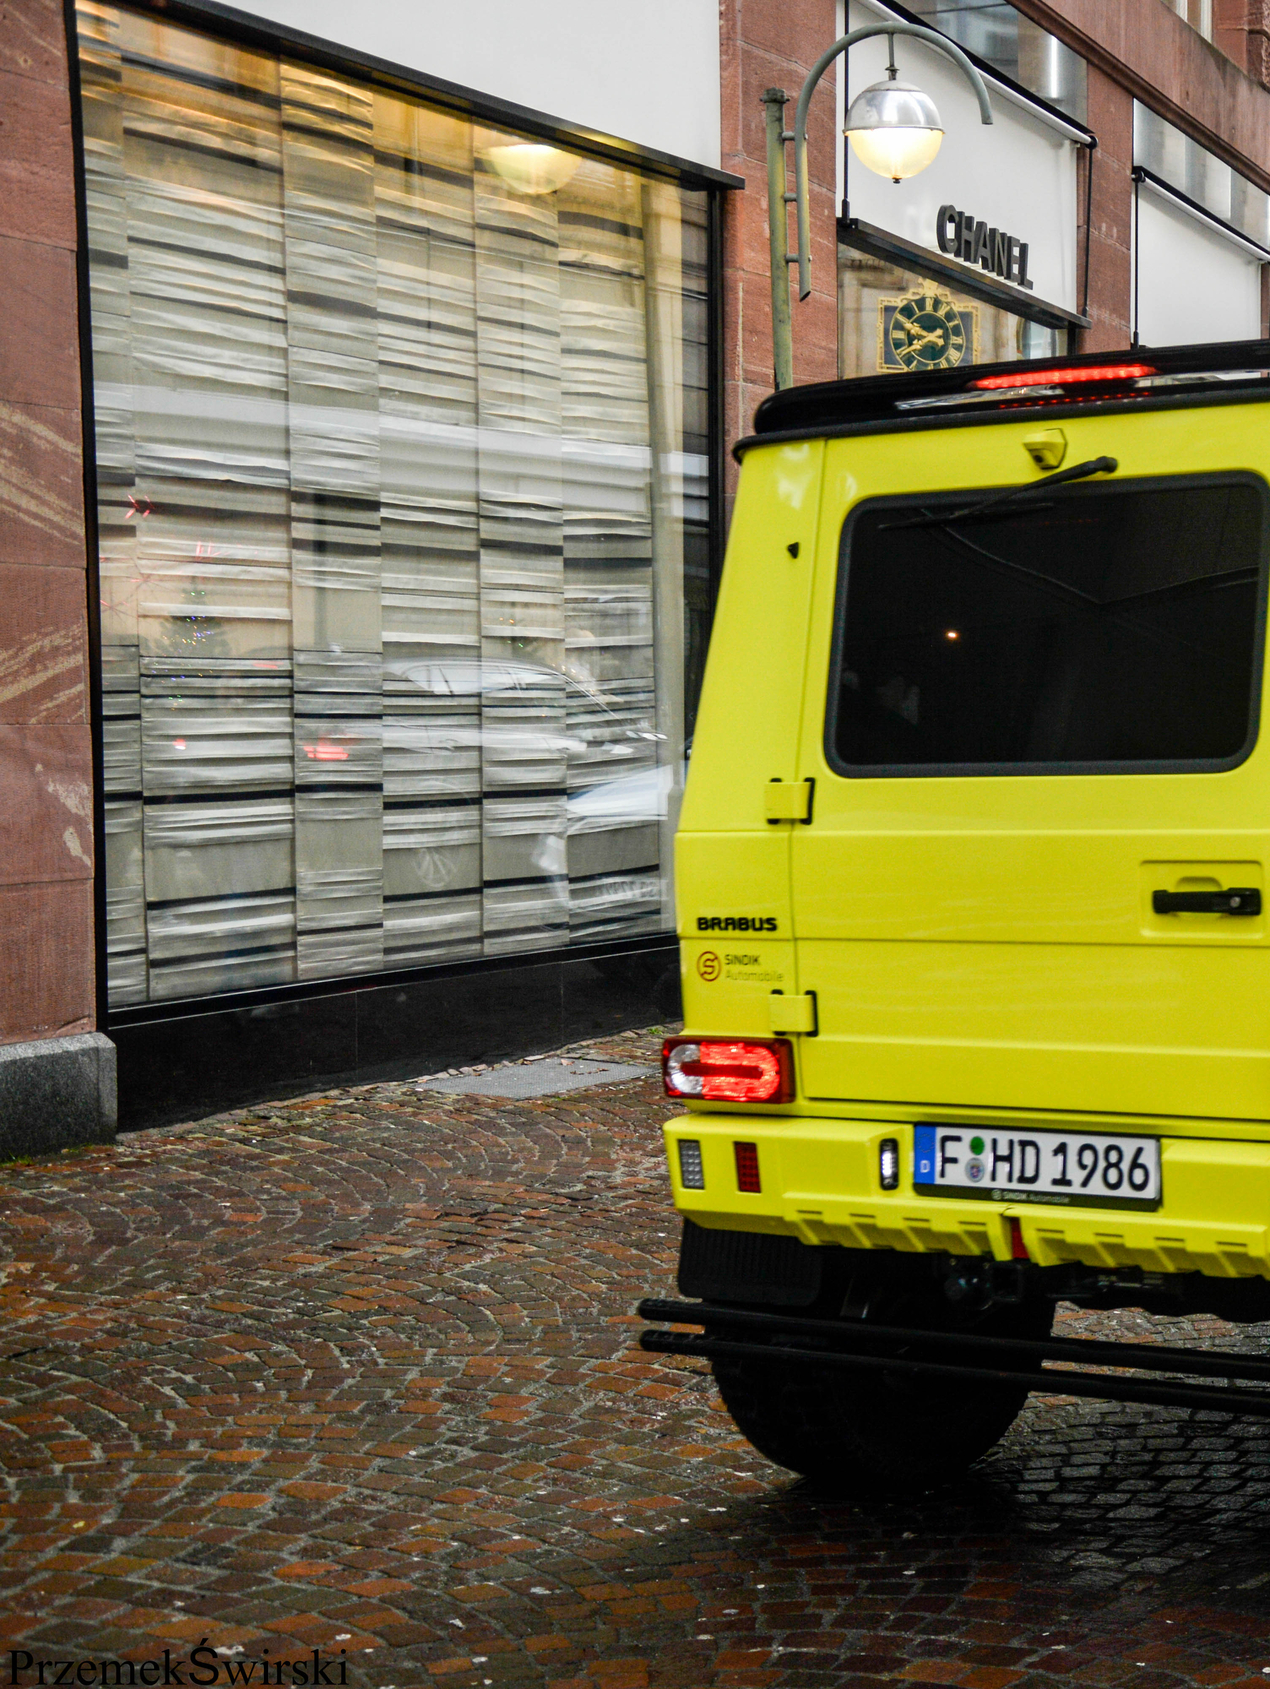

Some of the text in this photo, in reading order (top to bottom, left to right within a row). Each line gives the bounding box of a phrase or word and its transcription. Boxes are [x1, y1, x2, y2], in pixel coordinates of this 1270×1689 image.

[936, 204, 1034, 290] CHANEL
[697, 917, 778, 931] BRABUS
[725, 954, 761, 966] SINDIK
[920, 1160, 930, 1174] D
[939, 1135, 1150, 1192] F HD 1986
